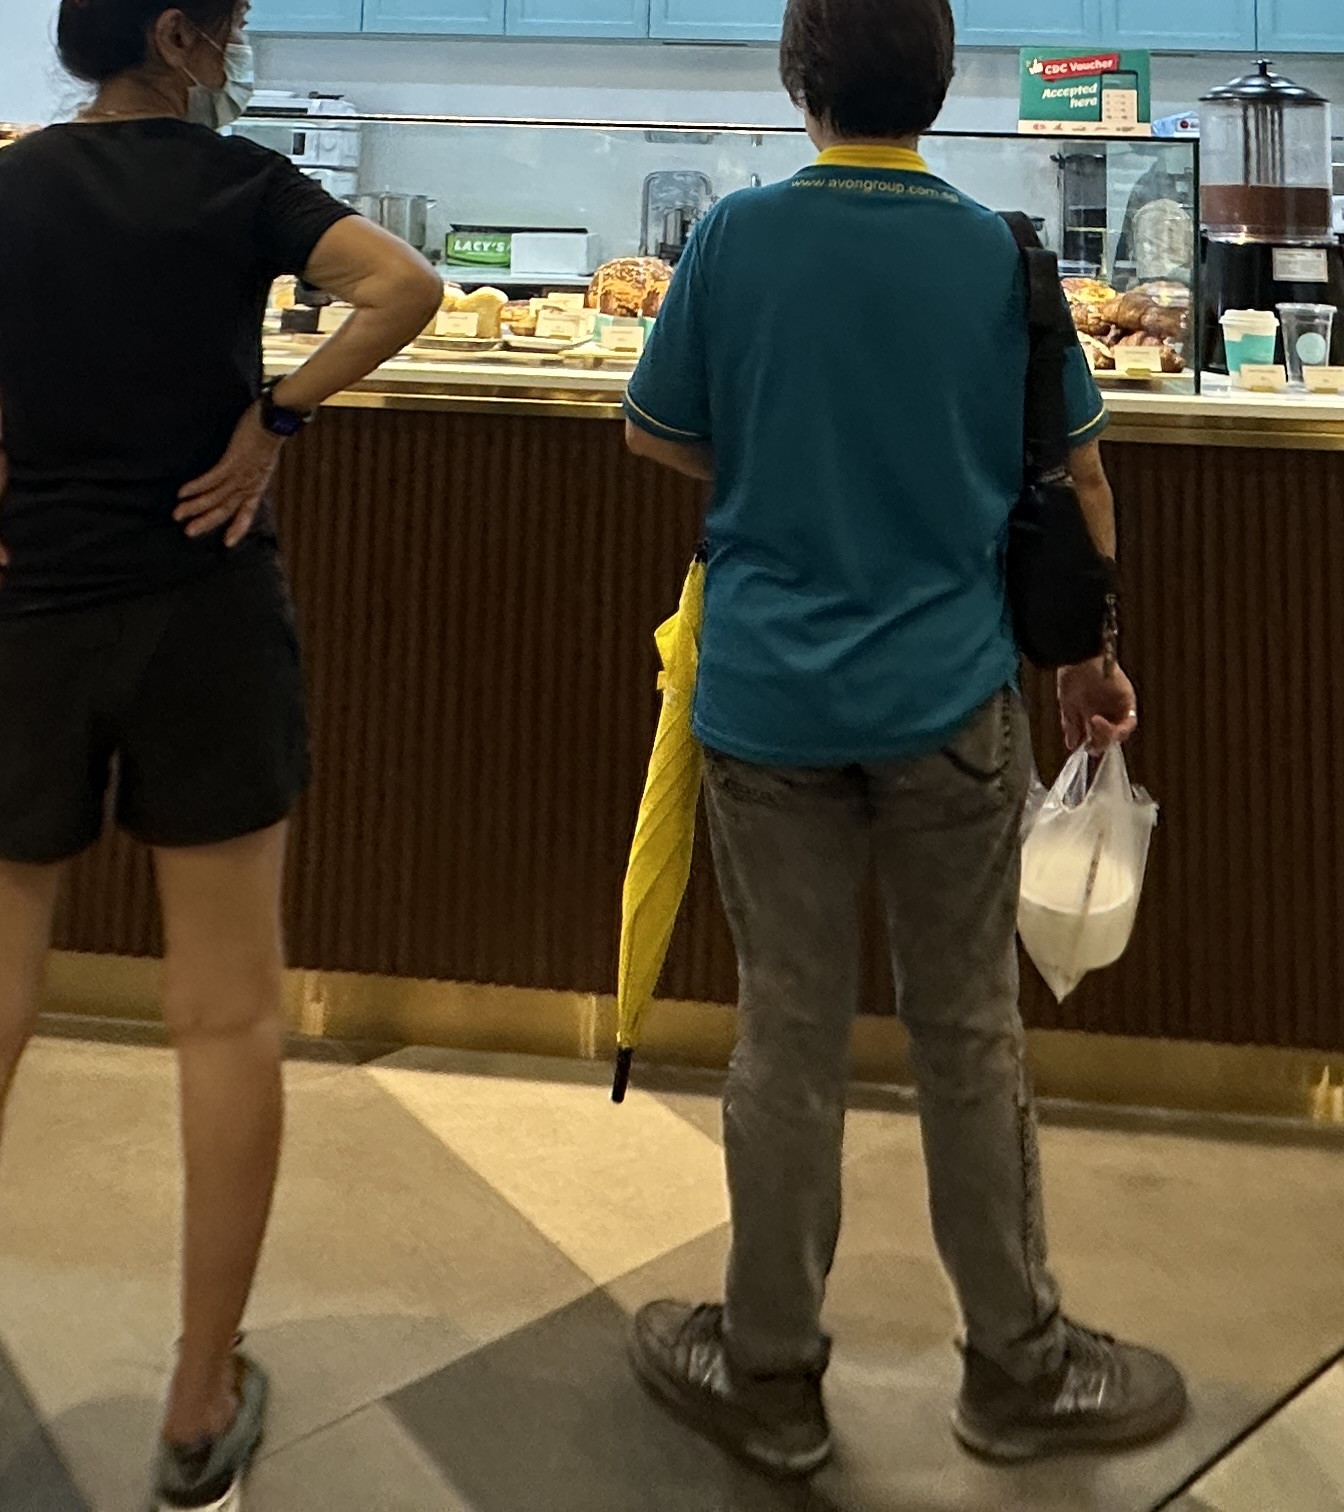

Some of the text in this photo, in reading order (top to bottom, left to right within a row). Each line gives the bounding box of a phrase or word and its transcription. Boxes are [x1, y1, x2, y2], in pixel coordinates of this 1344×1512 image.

[1044, 59, 1114, 75] CDC Voucher
[1042, 83, 1098, 100] Accepted
[1069, 97, 1098, 109] here
